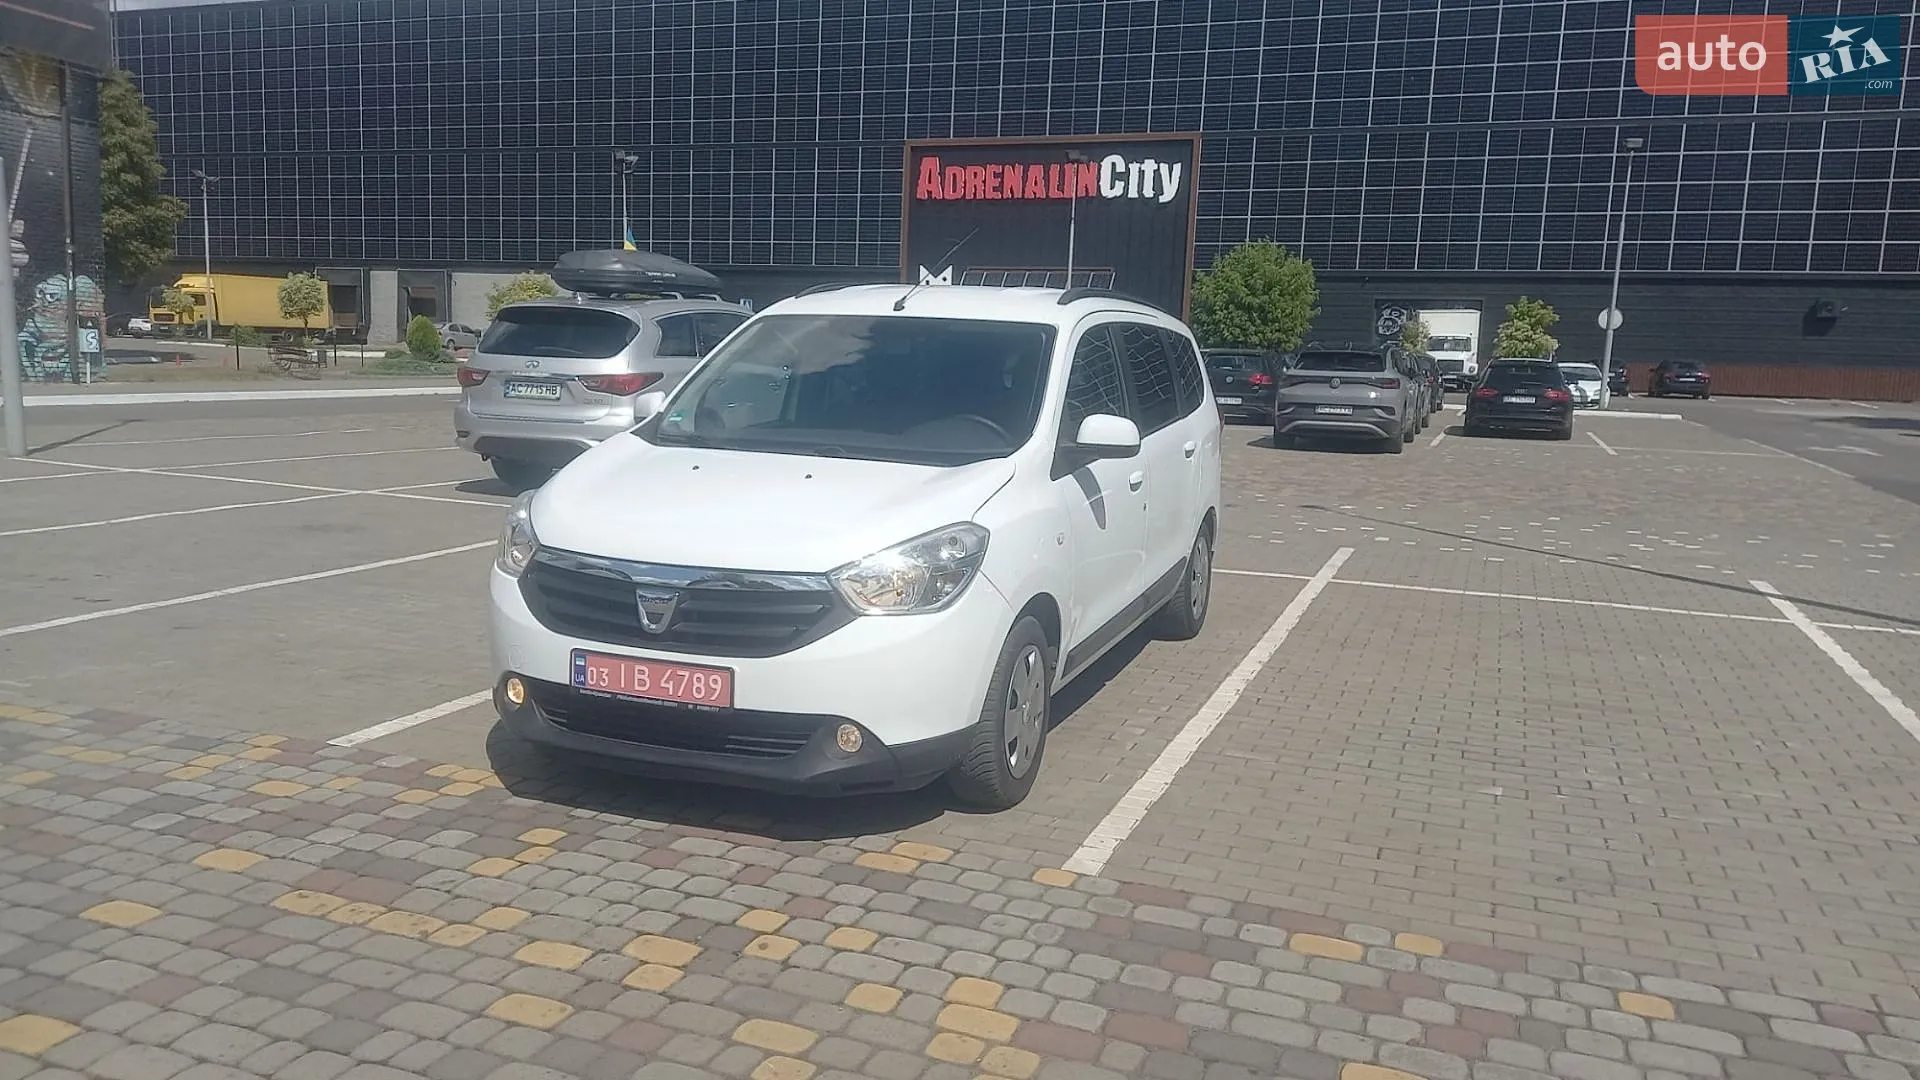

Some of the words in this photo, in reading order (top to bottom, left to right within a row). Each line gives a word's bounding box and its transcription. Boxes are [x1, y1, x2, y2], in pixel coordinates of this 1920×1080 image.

[575, 674, 585, 683] UA
[587, 667, 609, 687] 03
[660, 669, 722, 700] 4789
